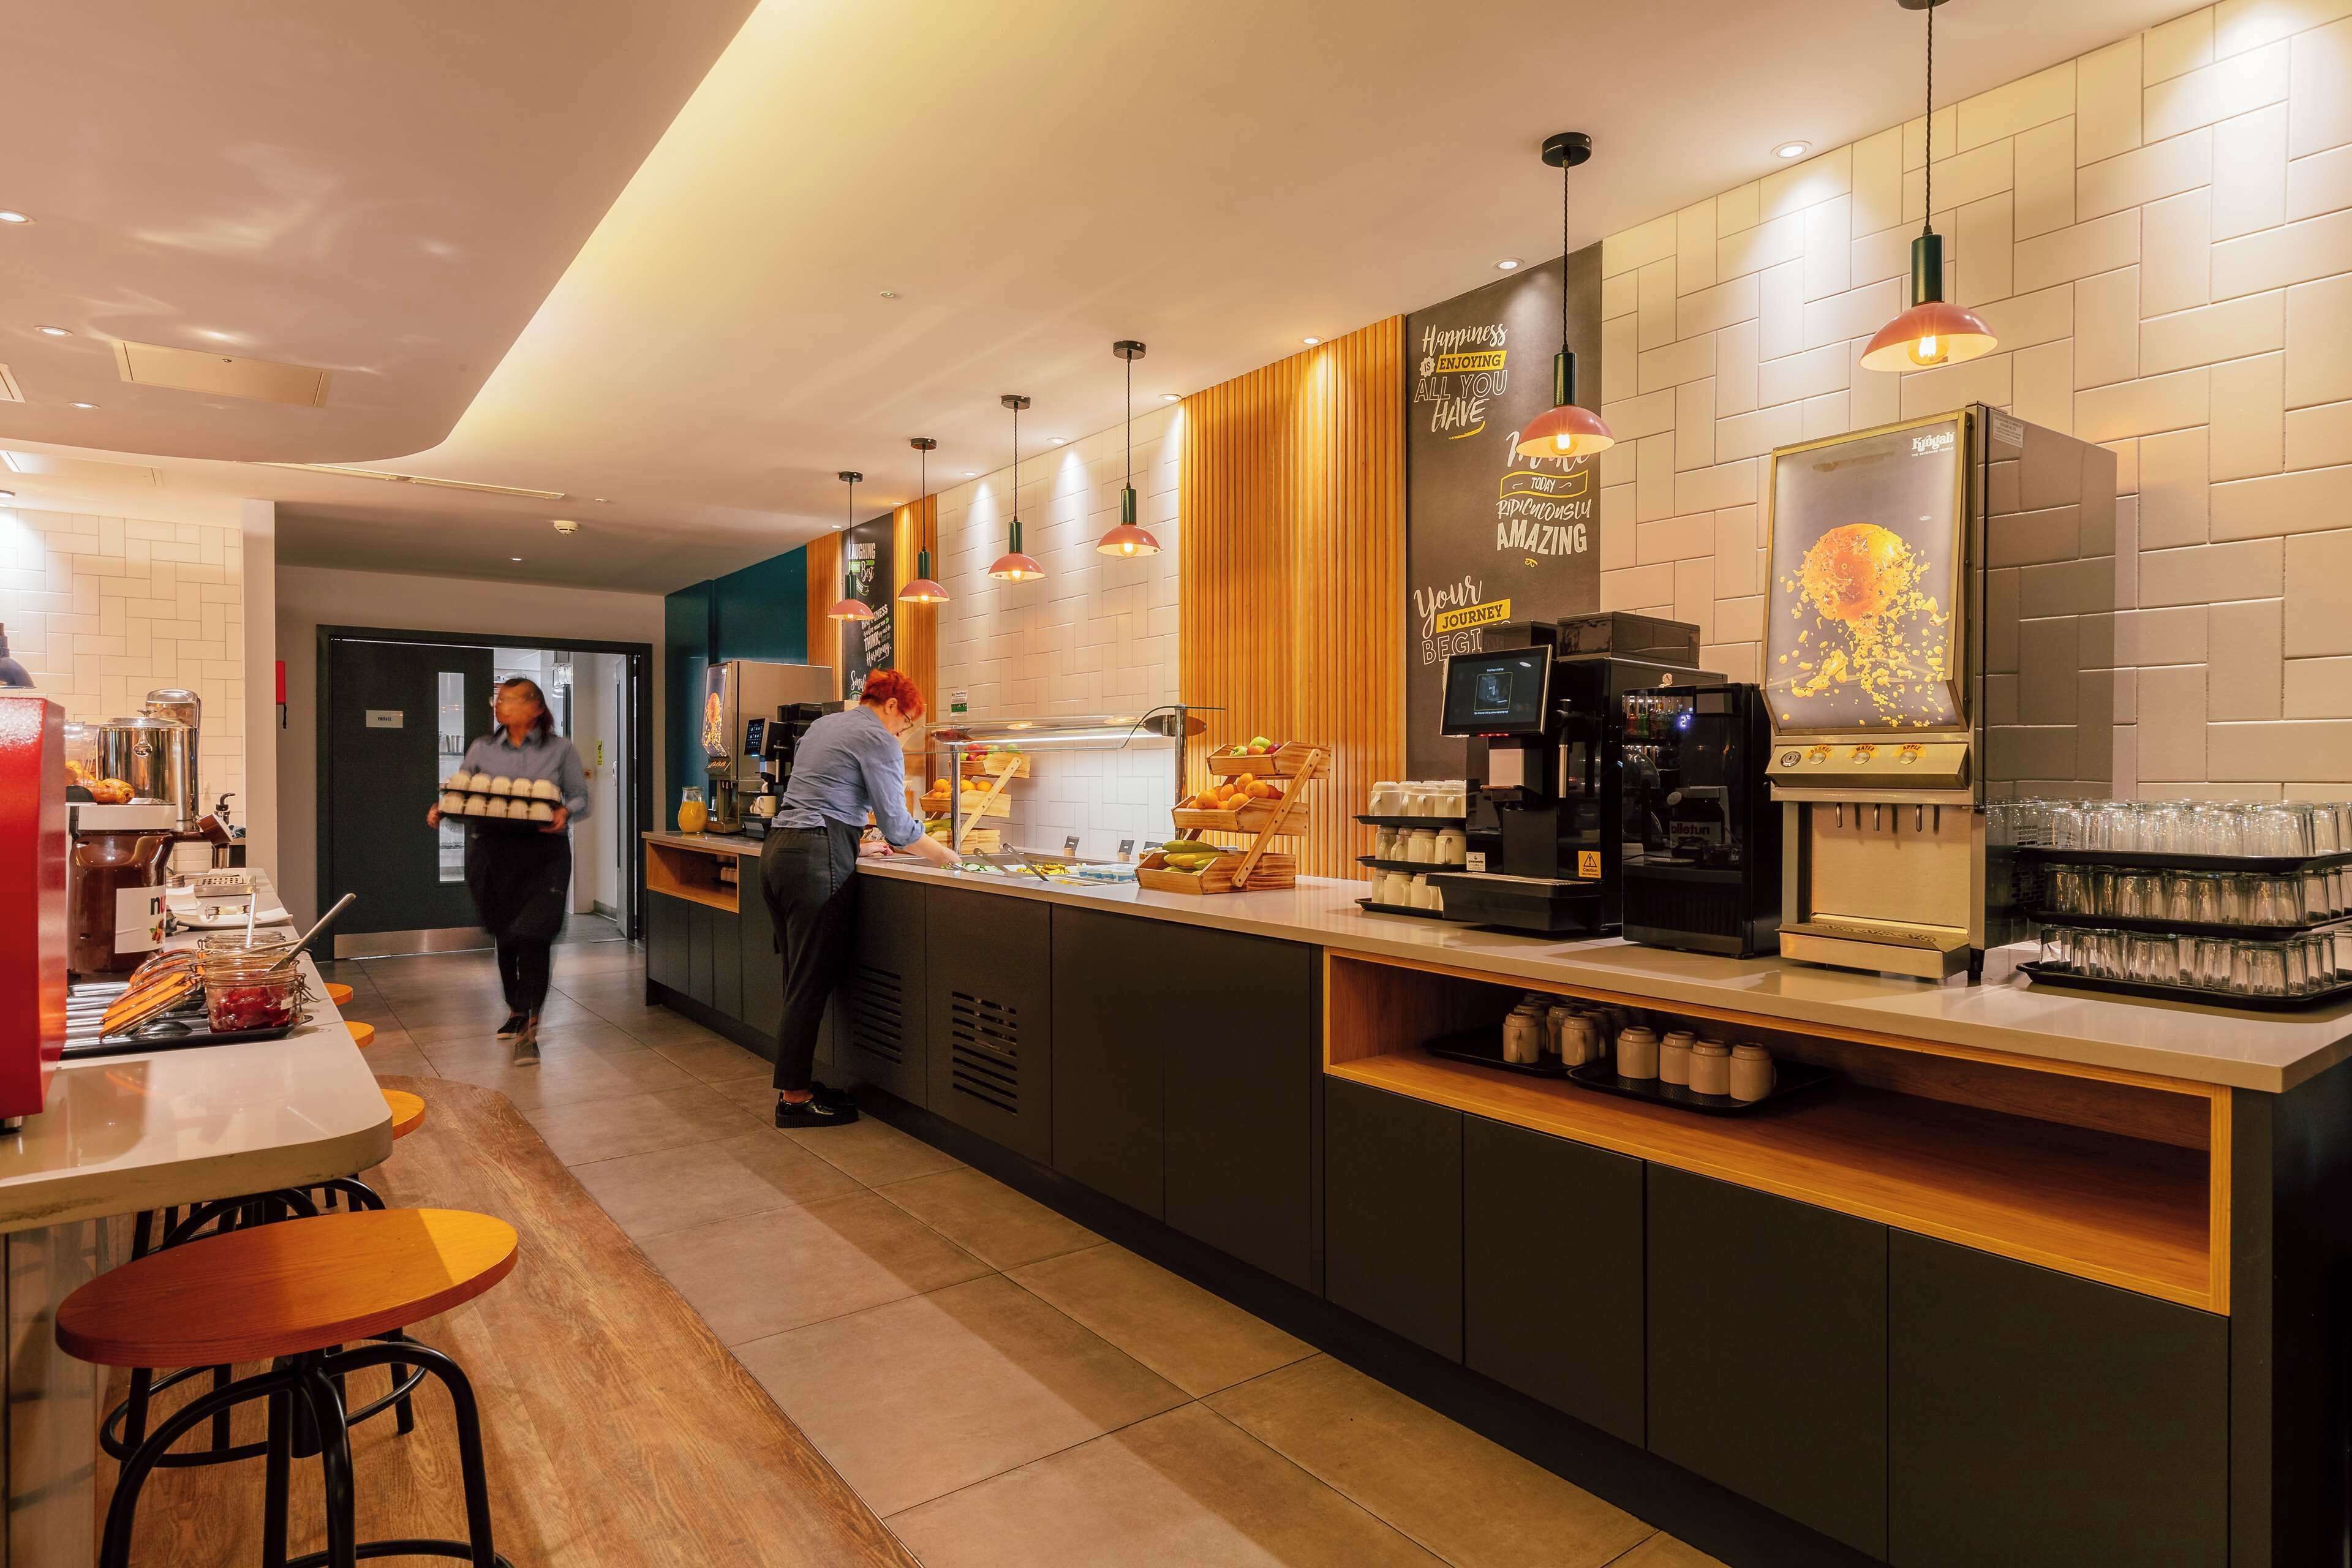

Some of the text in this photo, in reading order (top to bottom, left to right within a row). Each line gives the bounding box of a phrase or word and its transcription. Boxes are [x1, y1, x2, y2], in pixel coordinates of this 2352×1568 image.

[1422, 323, 1508, 356] Happiness
[1424, 354, 1502, 372] IS ENJOYING
[1414, 370, 1508, 403] ALL YOU
[1431, 396, 1490, 432] HAVE
[1531, 477, 1556, 493] TODAY
[1497, 519, 1588, 556] AMAZING
[861, 560, 875, 582] Best
[1413, 575, 1482, 639] Your
[1442, 604, 1503, 629] JOURNEY
[850, 670, 867, 692] Smil
